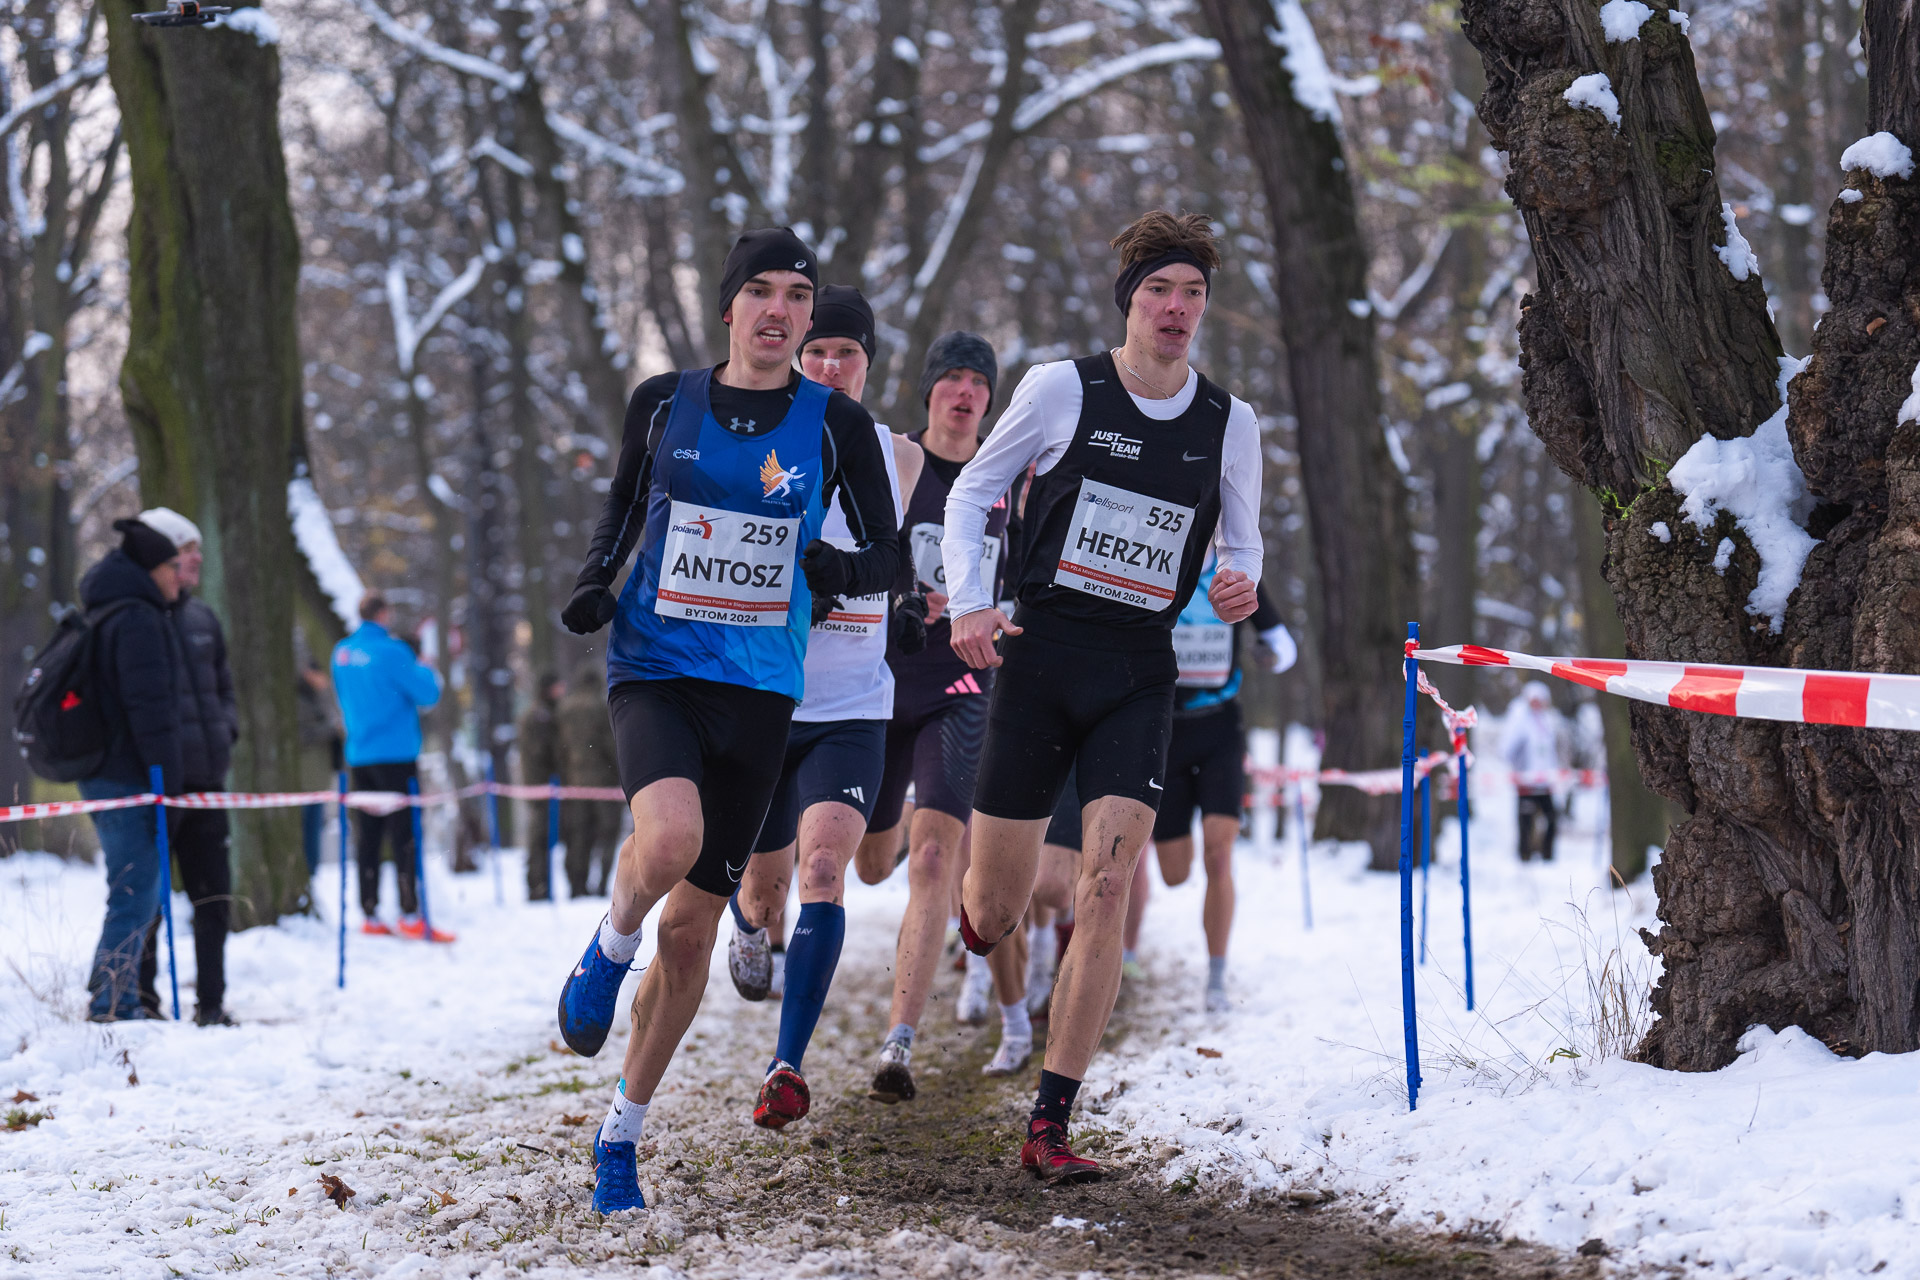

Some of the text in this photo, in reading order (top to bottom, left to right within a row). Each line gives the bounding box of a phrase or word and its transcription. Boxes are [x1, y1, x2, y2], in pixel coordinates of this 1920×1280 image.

[1090, 430, 1122, 442] JUST
[1110, 442, 1141, 456] TEAM
[1146, 506, 1185, 533] 525
[672, 525, 702, 536] polanik
[741, 522, 788, 546] 259
[1076, 527, 1174, 574] HERZYK
[671, 553, 784, 588] ANTOSZ
[681, 595, 711, 604] Mistrzostwa
[1084, 582, 1147, 606] BYTOM 2024
[685, 608, 758, 623] BYTOM 2024
[843, 624, 868, 633] 2024
